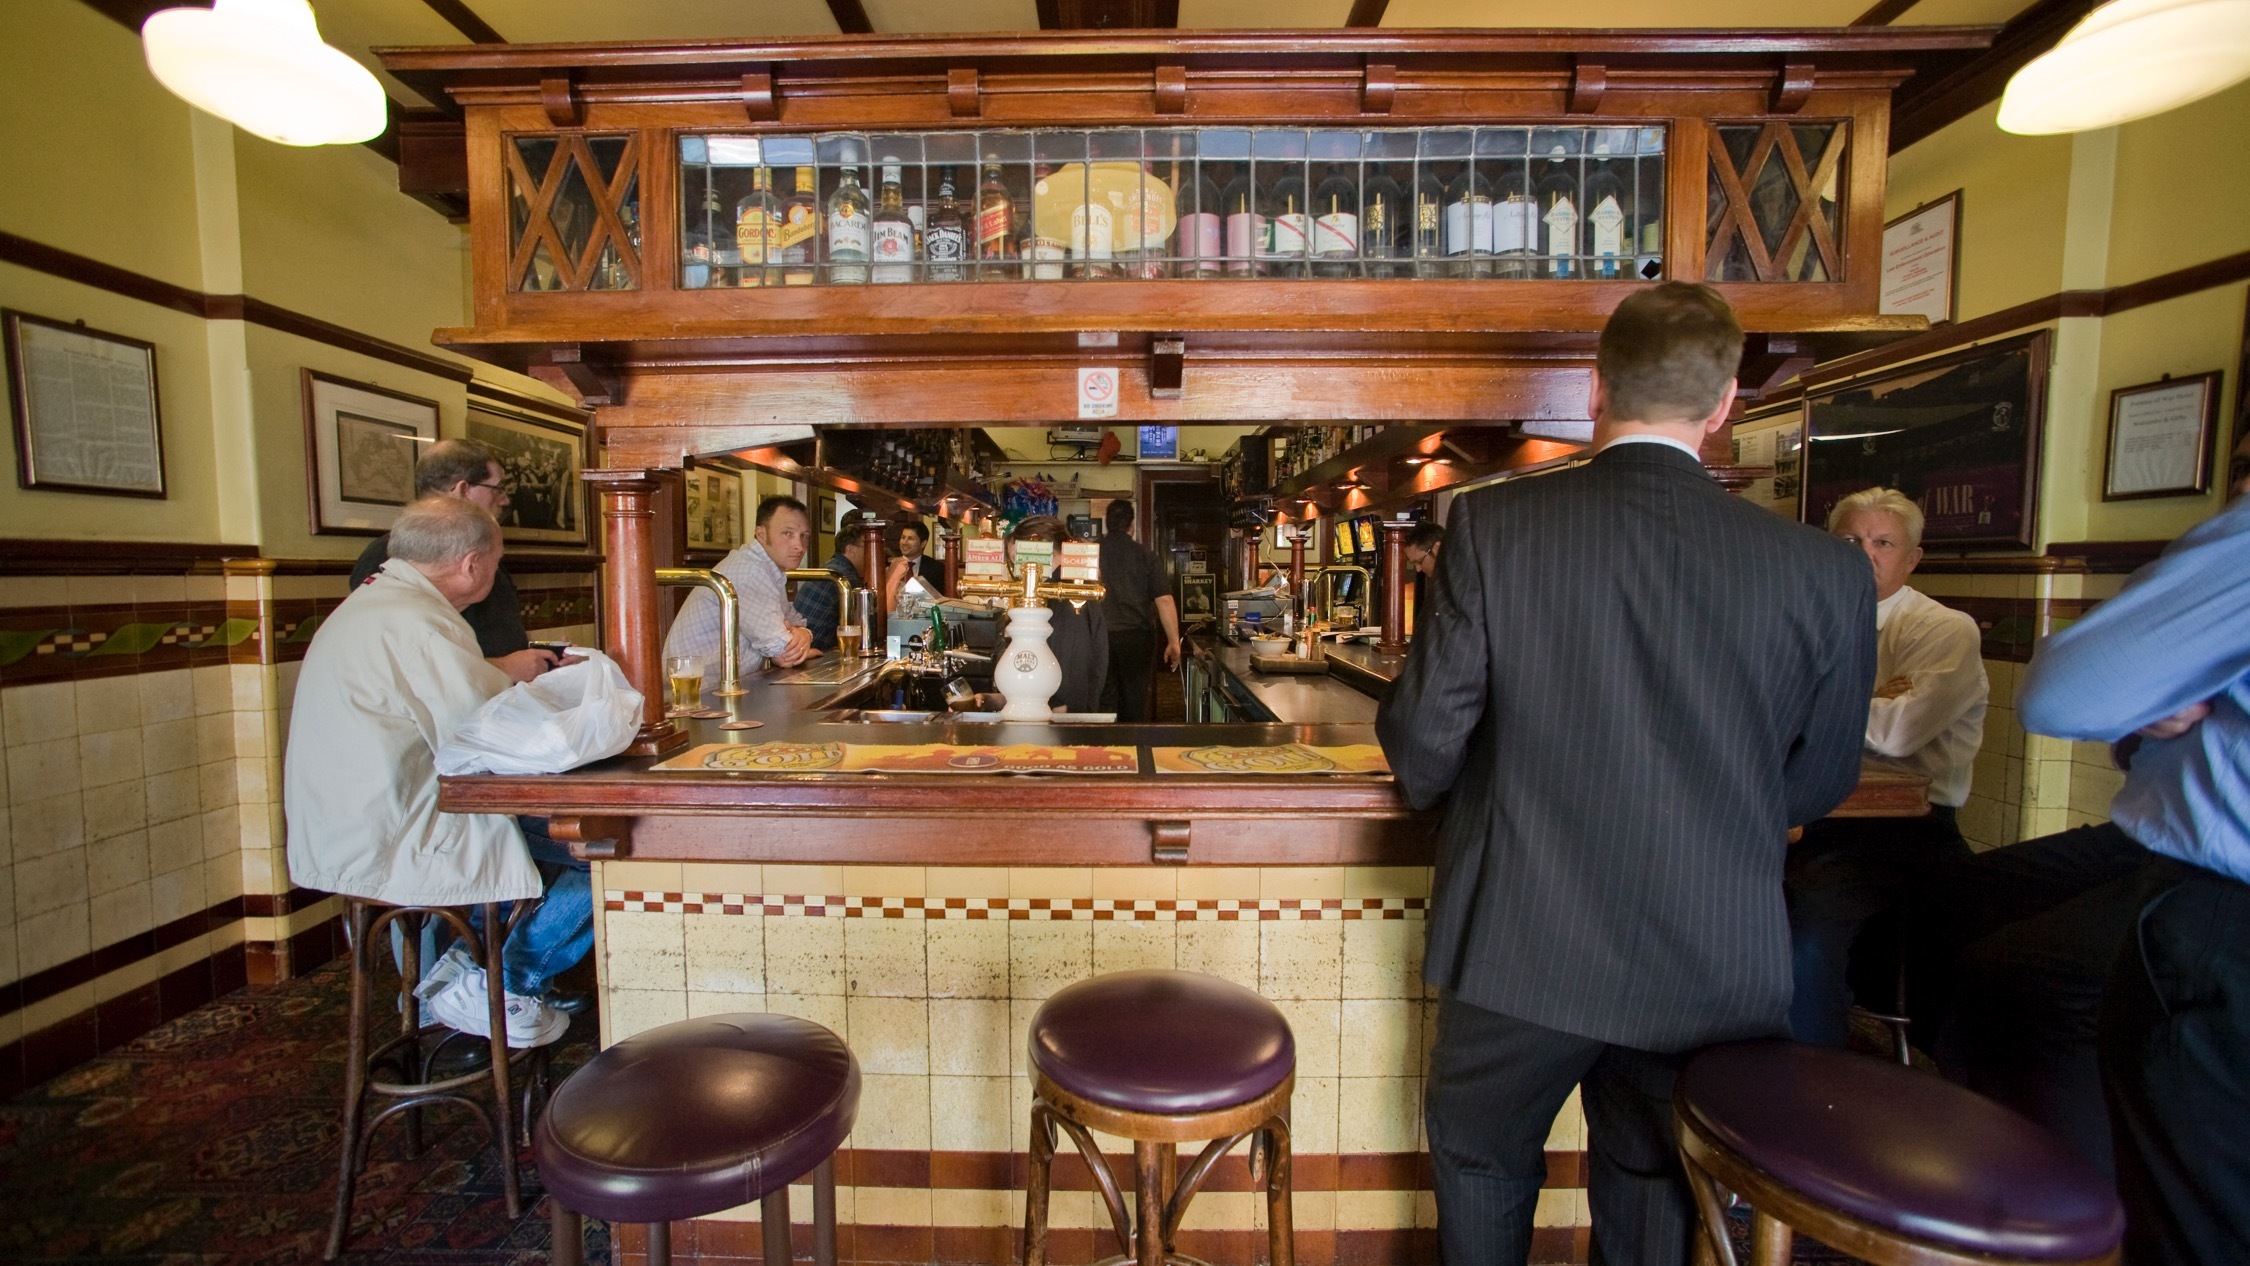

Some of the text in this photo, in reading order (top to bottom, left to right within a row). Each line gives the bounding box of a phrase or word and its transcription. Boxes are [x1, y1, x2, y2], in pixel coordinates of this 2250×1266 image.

[830, 219, 866, 231] BACARDI
[874, 227, 909, 245] JIM BEAM
[926, 231, 940, 245] JACK
